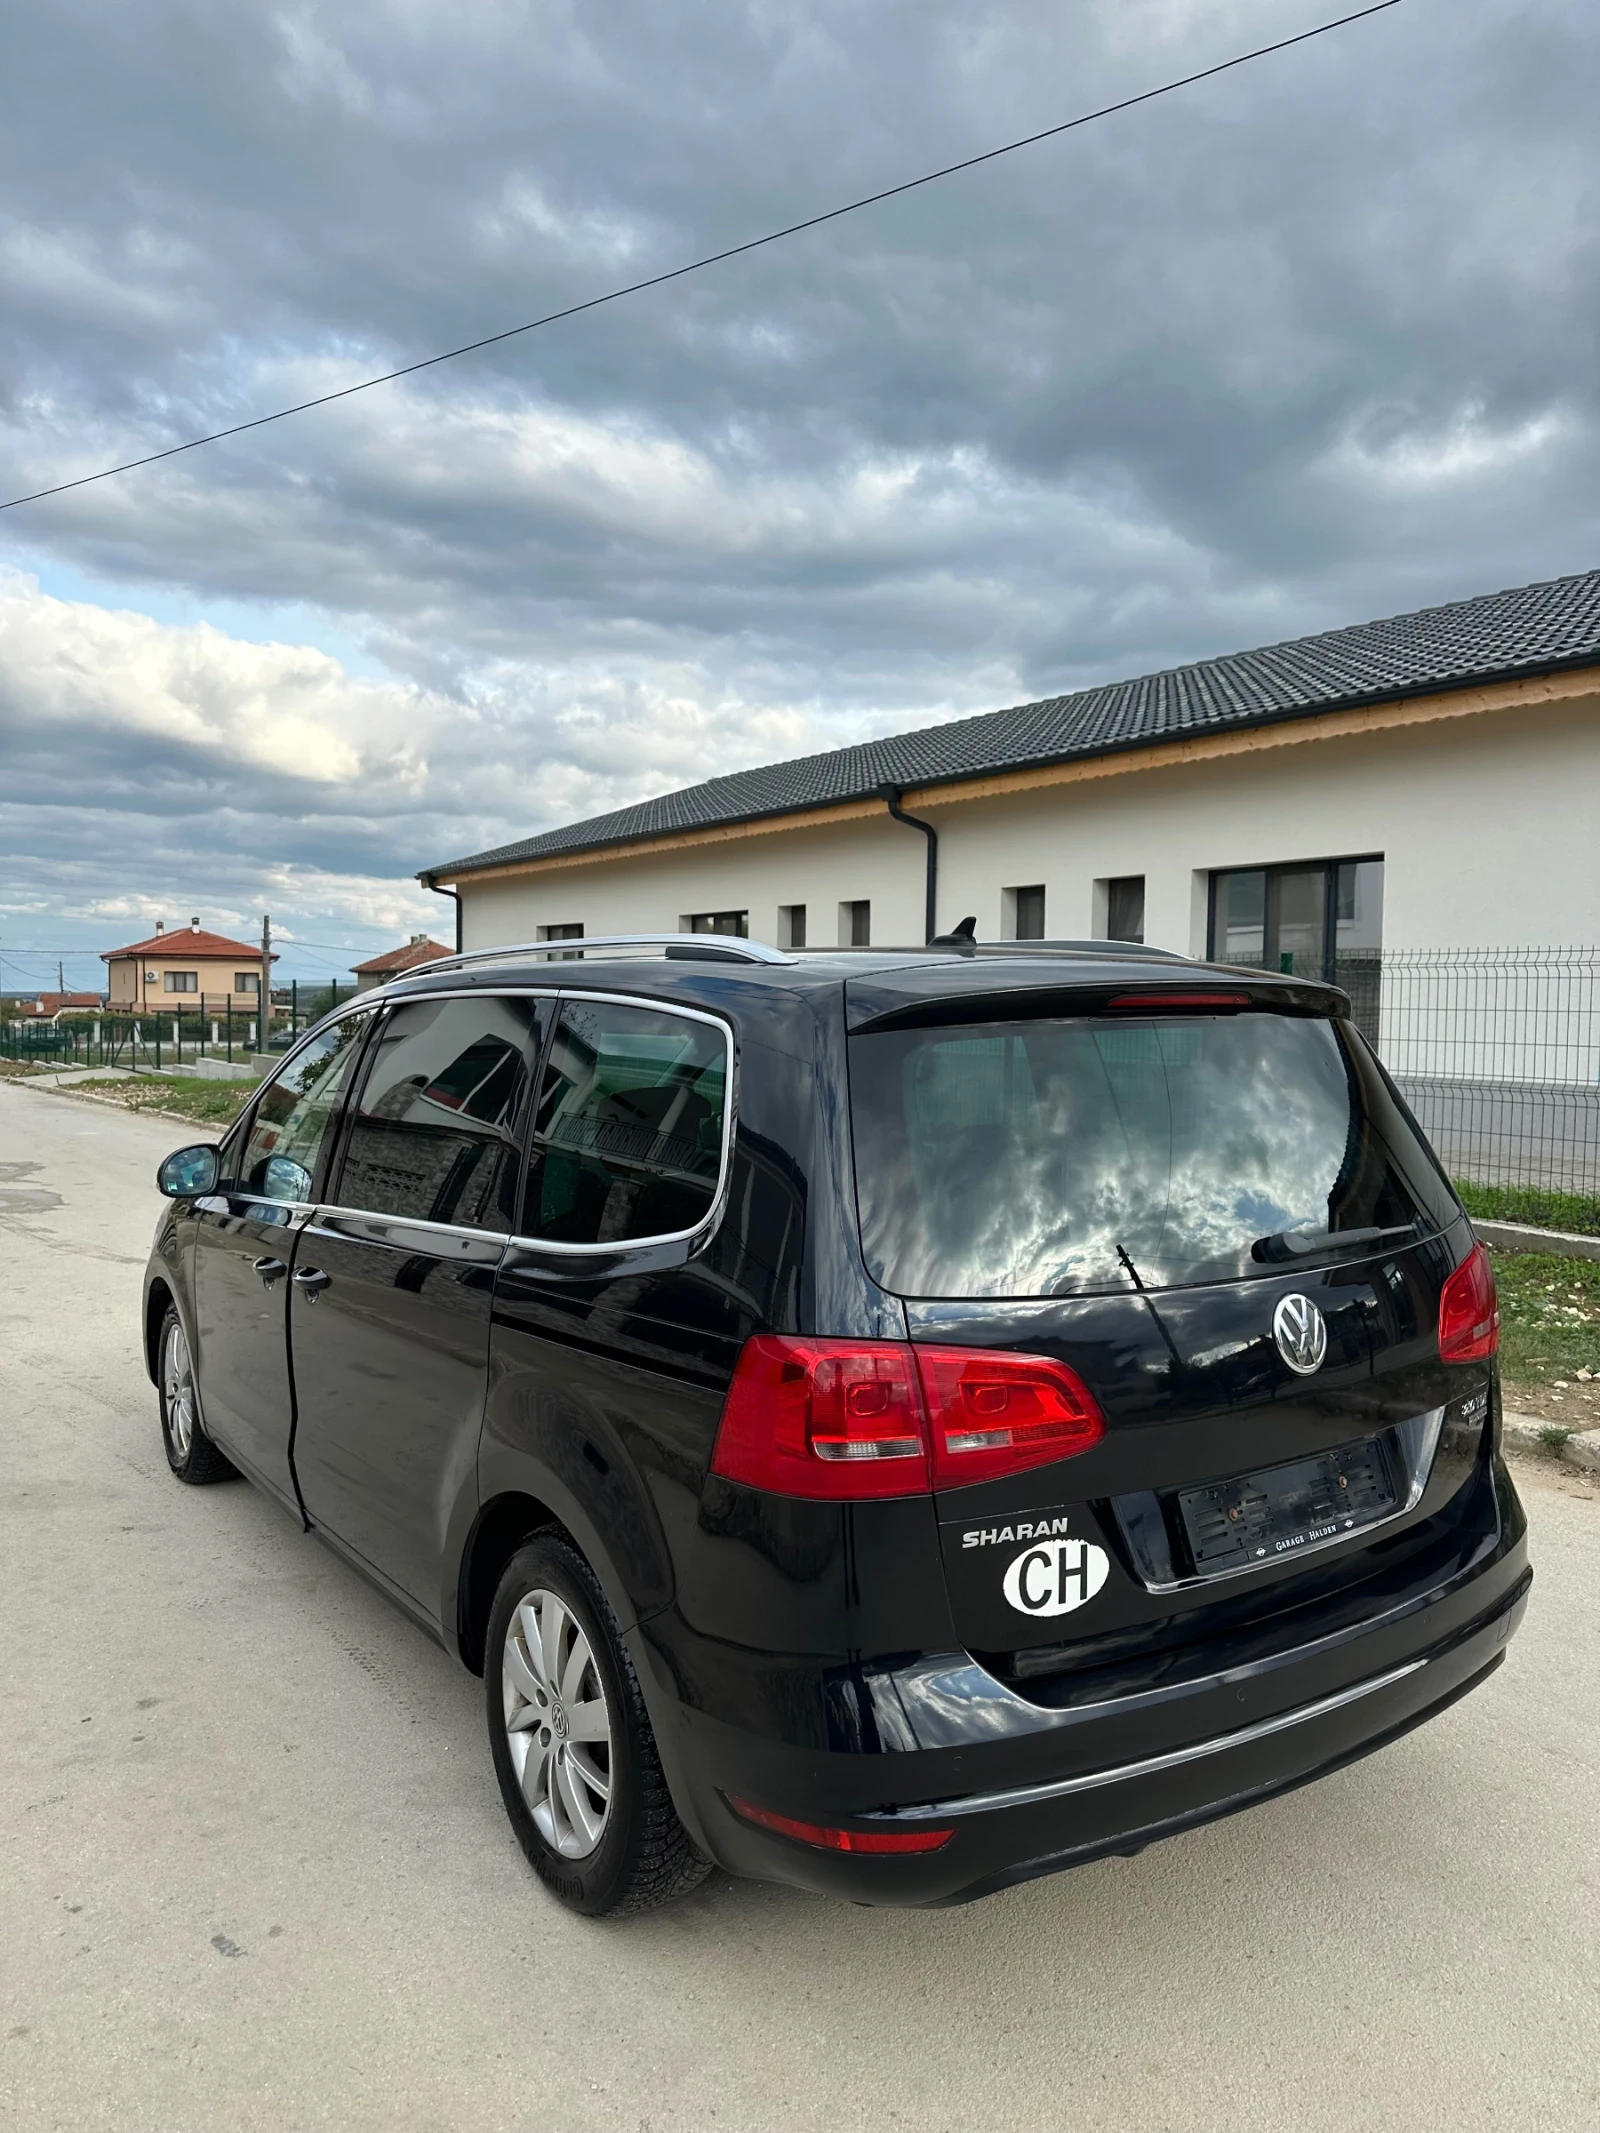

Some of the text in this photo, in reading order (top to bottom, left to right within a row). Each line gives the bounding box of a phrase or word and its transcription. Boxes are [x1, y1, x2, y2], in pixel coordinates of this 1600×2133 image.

[1274, 1292, 1326, 1374] VW
[962, 1517, 1068, 1548] SHARAN
[1275, 1524, 1337, 1551] GARAGE HALDEN
[1018, 1544, 1088, 1610] CH
